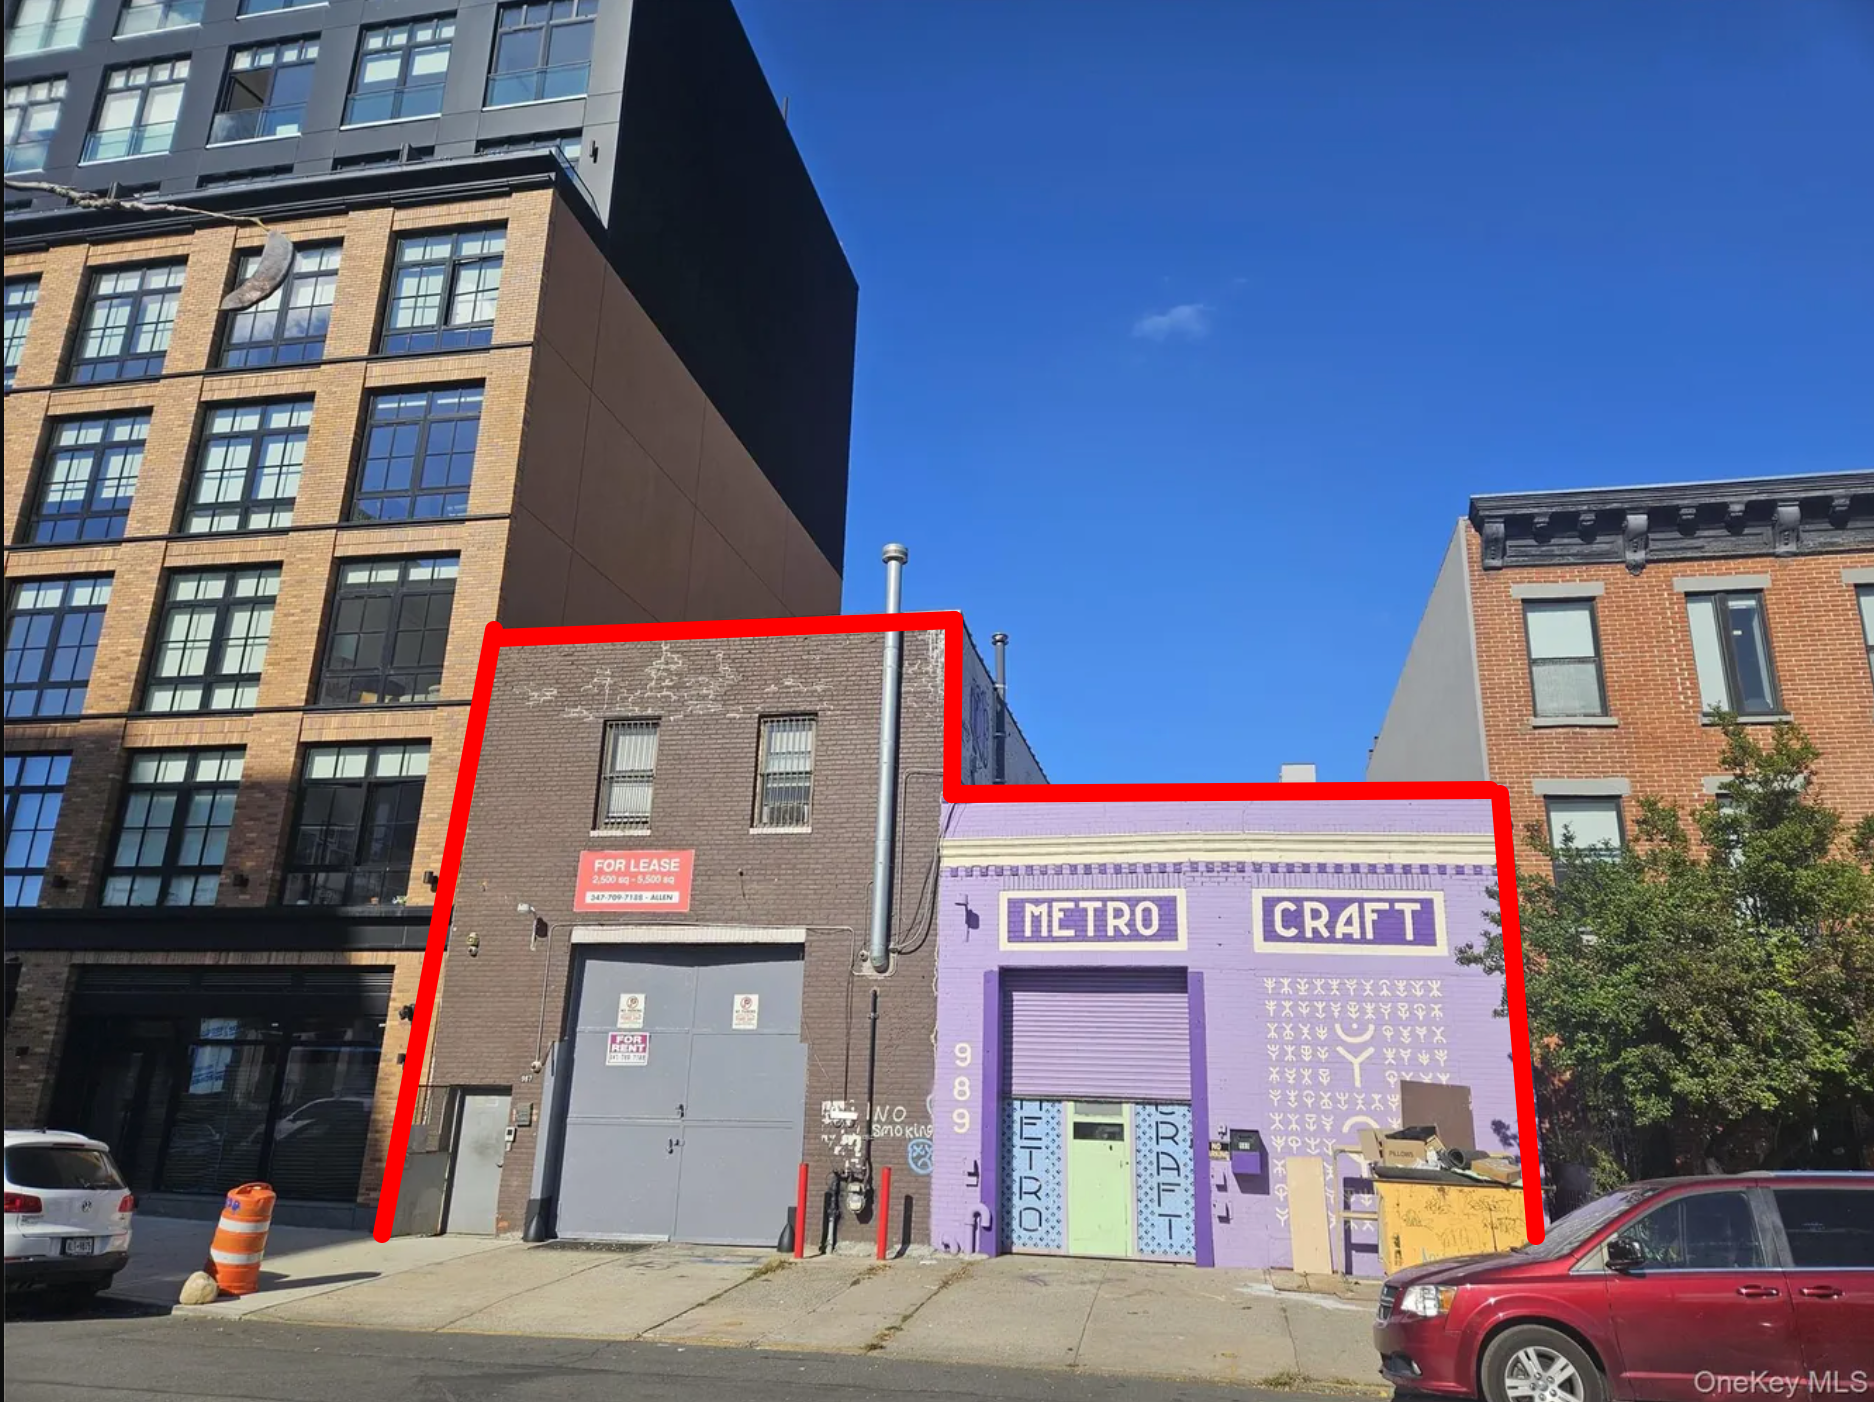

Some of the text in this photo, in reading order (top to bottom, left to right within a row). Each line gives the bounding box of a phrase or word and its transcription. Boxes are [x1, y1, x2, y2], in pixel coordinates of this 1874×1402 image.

[593, 857, 680, 873] FOR LEASE
[650, 893, 673, 902] ALLEN
[1024, 901, 1159, 937] METRO
[1273, 901, 1421, 941] CRAFT
[615, 1034, 643, 1044] FOR
[611, 1043, 646, 1054] RENT
[952, 1043, 972, 1134] 989
[873, 1104, 907, 1122] NO
